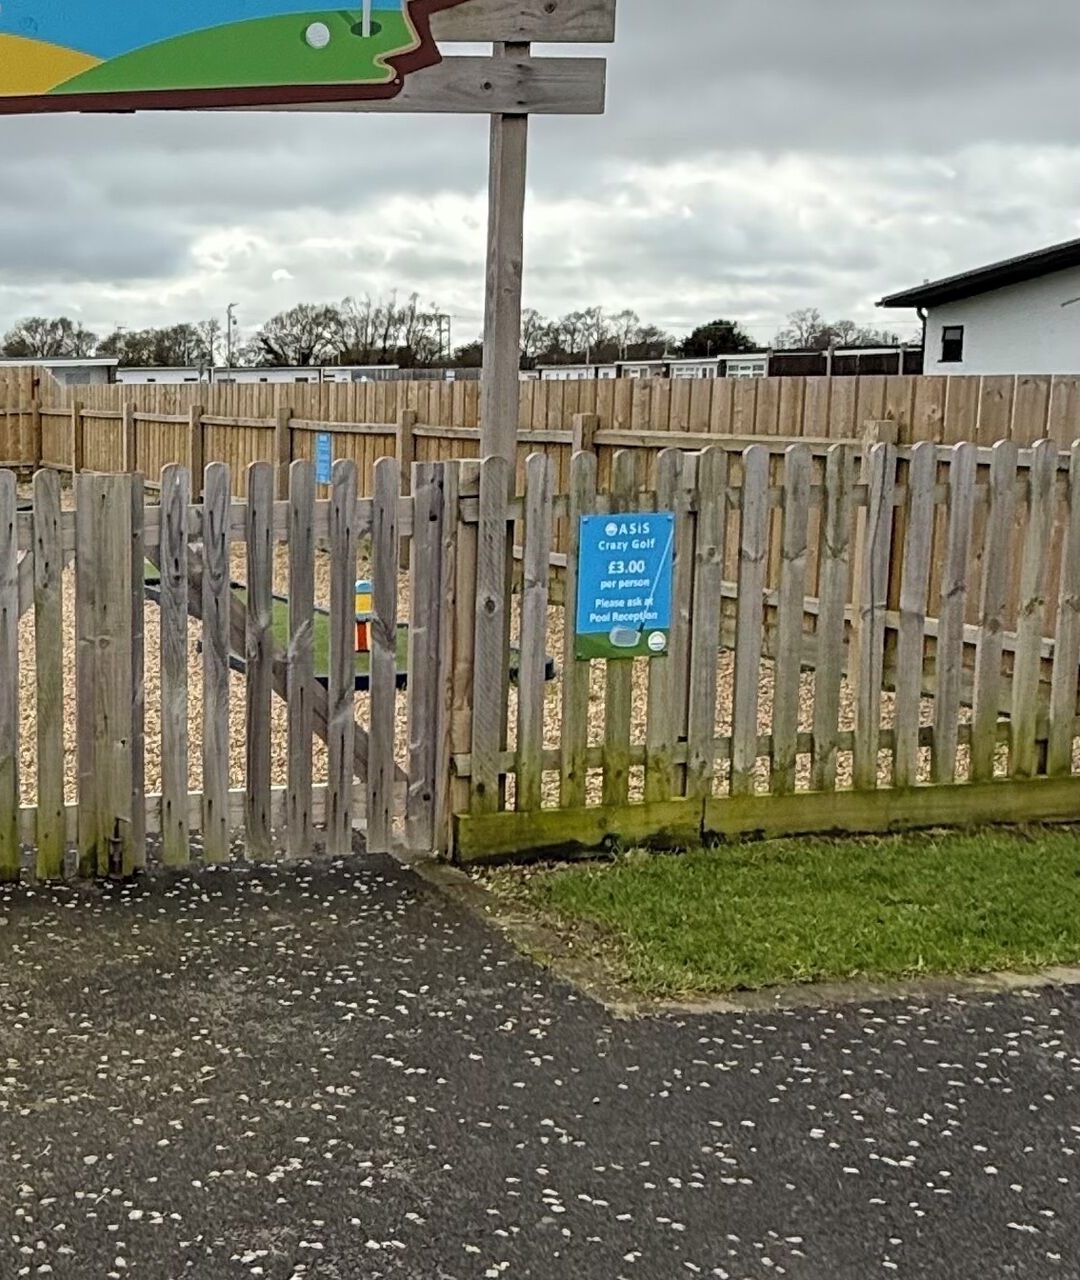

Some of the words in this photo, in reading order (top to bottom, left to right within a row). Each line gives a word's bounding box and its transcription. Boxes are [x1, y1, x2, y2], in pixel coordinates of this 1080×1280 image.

[598, 540, 628, 552] Crazy
[632, 538, 656, 549] Golf
[608, 560, 645, 574] £3.00
[600, 580, 616, 590] per
[618, 578, 650, 589] person
[595, 598, 624, 608] Please
[627, 597, 642, 608] ask
[589, 613, 611, 623] Pool
[612, 611, 658, 623] Reception
